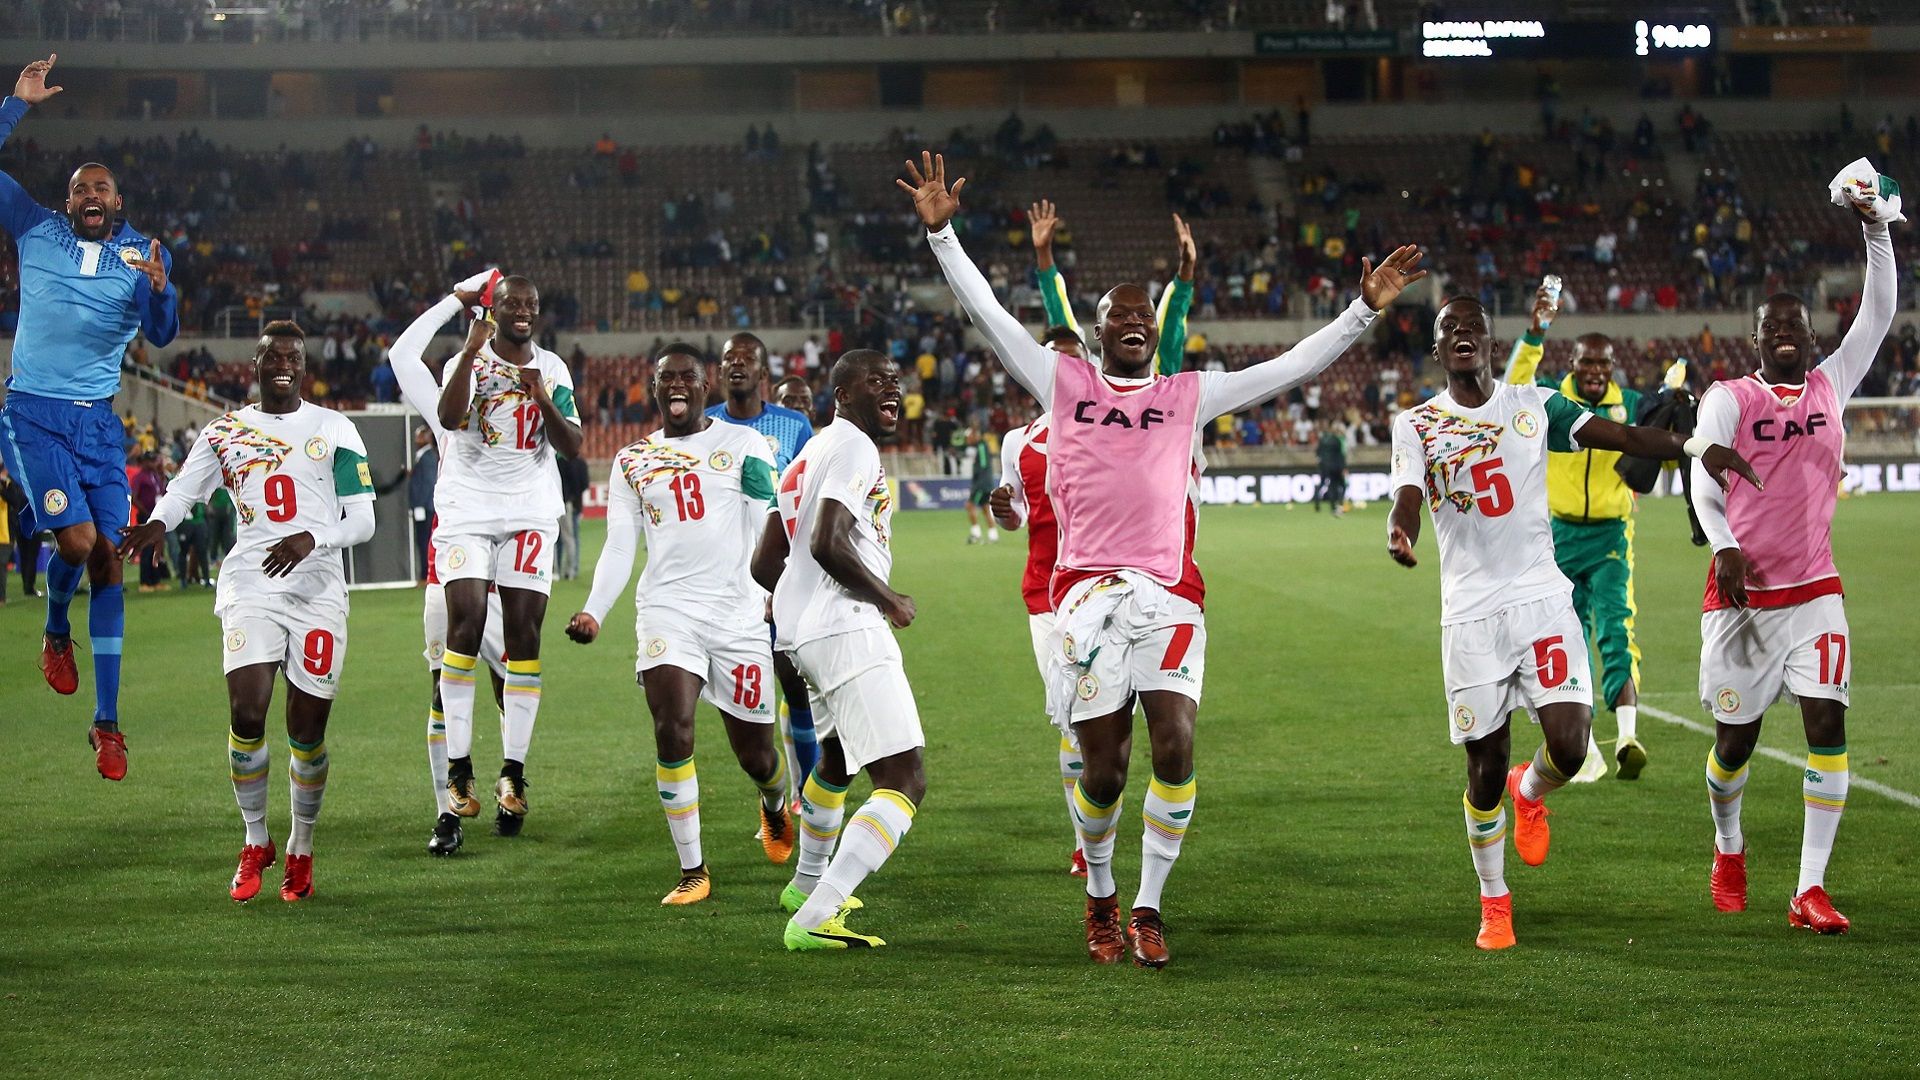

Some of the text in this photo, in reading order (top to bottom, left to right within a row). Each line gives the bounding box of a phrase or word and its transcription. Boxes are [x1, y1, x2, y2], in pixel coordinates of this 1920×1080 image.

[77, 240, 102, 276] 1
[513, 403, 540, 450] 12
[1753, 413, 1827, 441] CAF
[264, 474, 297, 523] 9
[669, 473, 705, 522] 13
[1200, 475, 1257, 504] ABC
[1470, 457, 1515, 518] 5
[514, 530, 543, 575] 12
[304, 629, 334, 677] 9
[1532, 635, 1568, 689] 5
[1814, 632, 1846, 686] 17
[731, 663, 761, 709] 13
